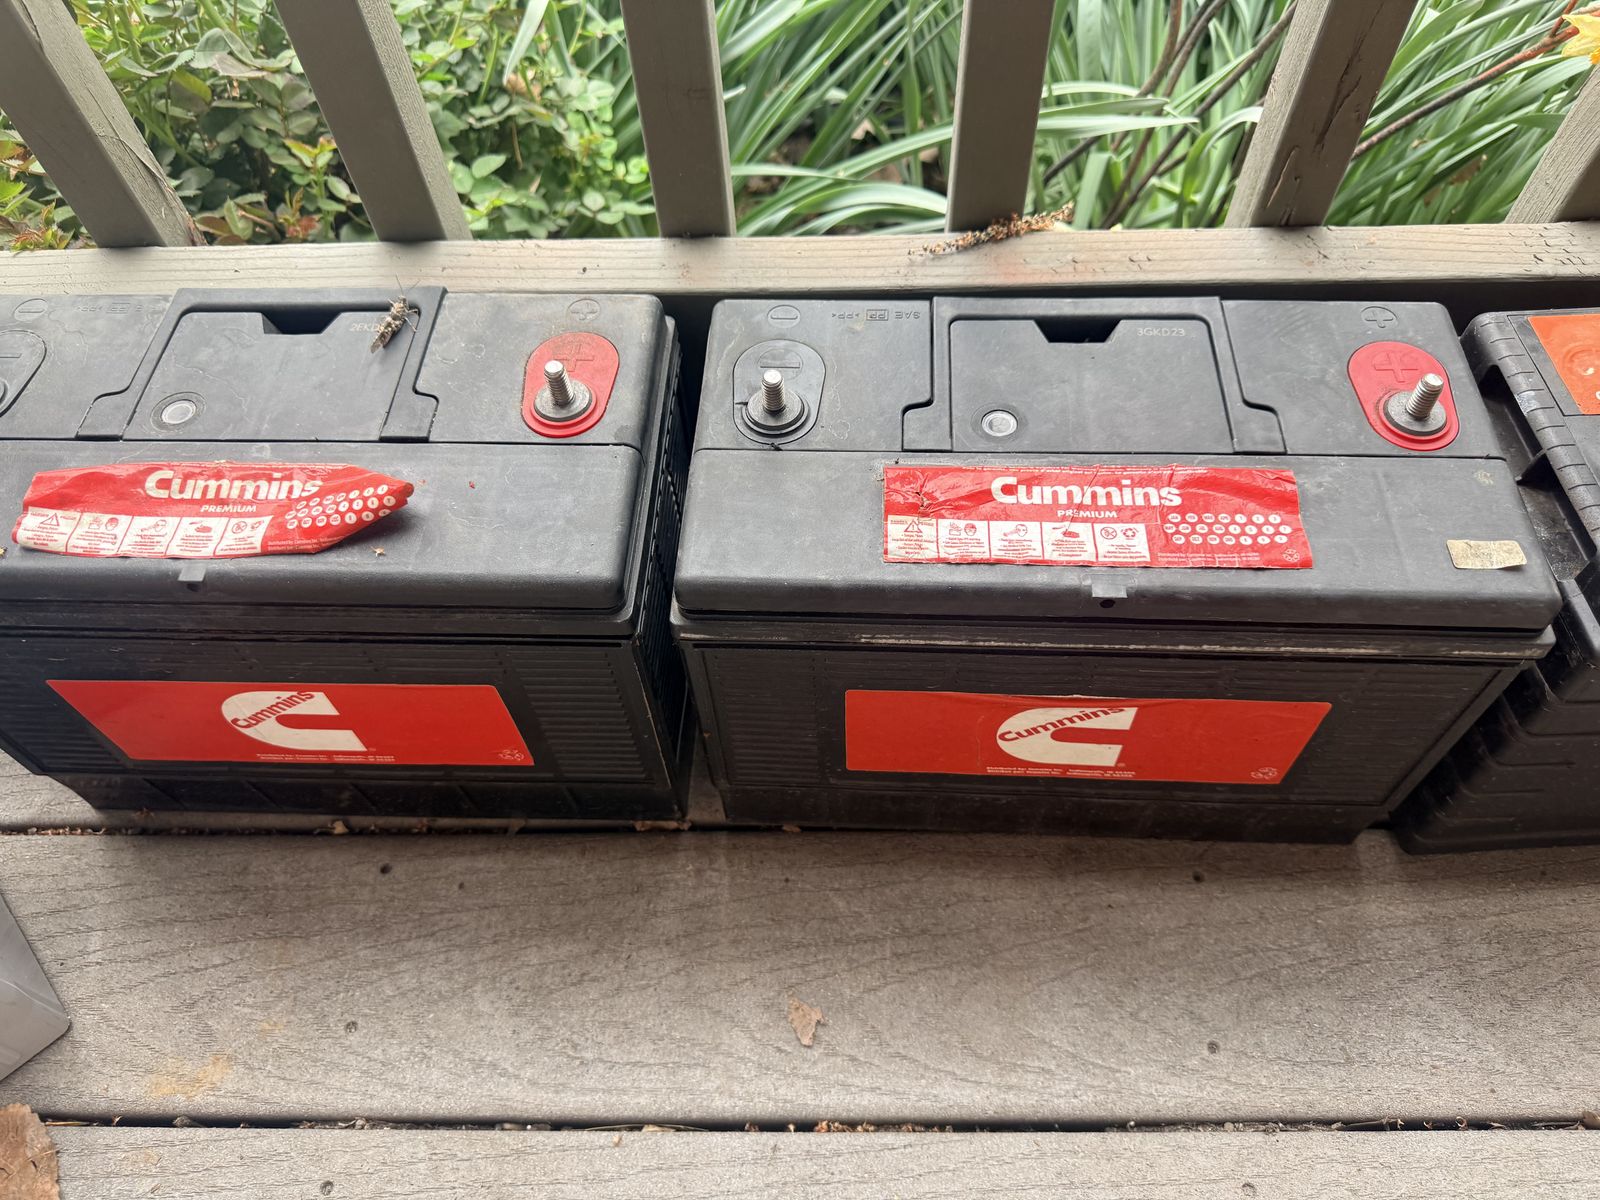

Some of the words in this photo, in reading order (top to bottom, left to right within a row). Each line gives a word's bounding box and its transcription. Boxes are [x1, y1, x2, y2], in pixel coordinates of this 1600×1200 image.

[895, 311, 921, 320] SAE
[1136, 327, 1186, 337] 3GKD23
[144, 469, 324, 500] Cummins
[990, 475, 1183, 507] Cummins
[200, 504, 257, 513] PREMIUM
[1057, 509, 1118, 519] PREMIUM
[230, 691, 315, 729] Cummins
[997, 707, 1126, 742] Cummins
